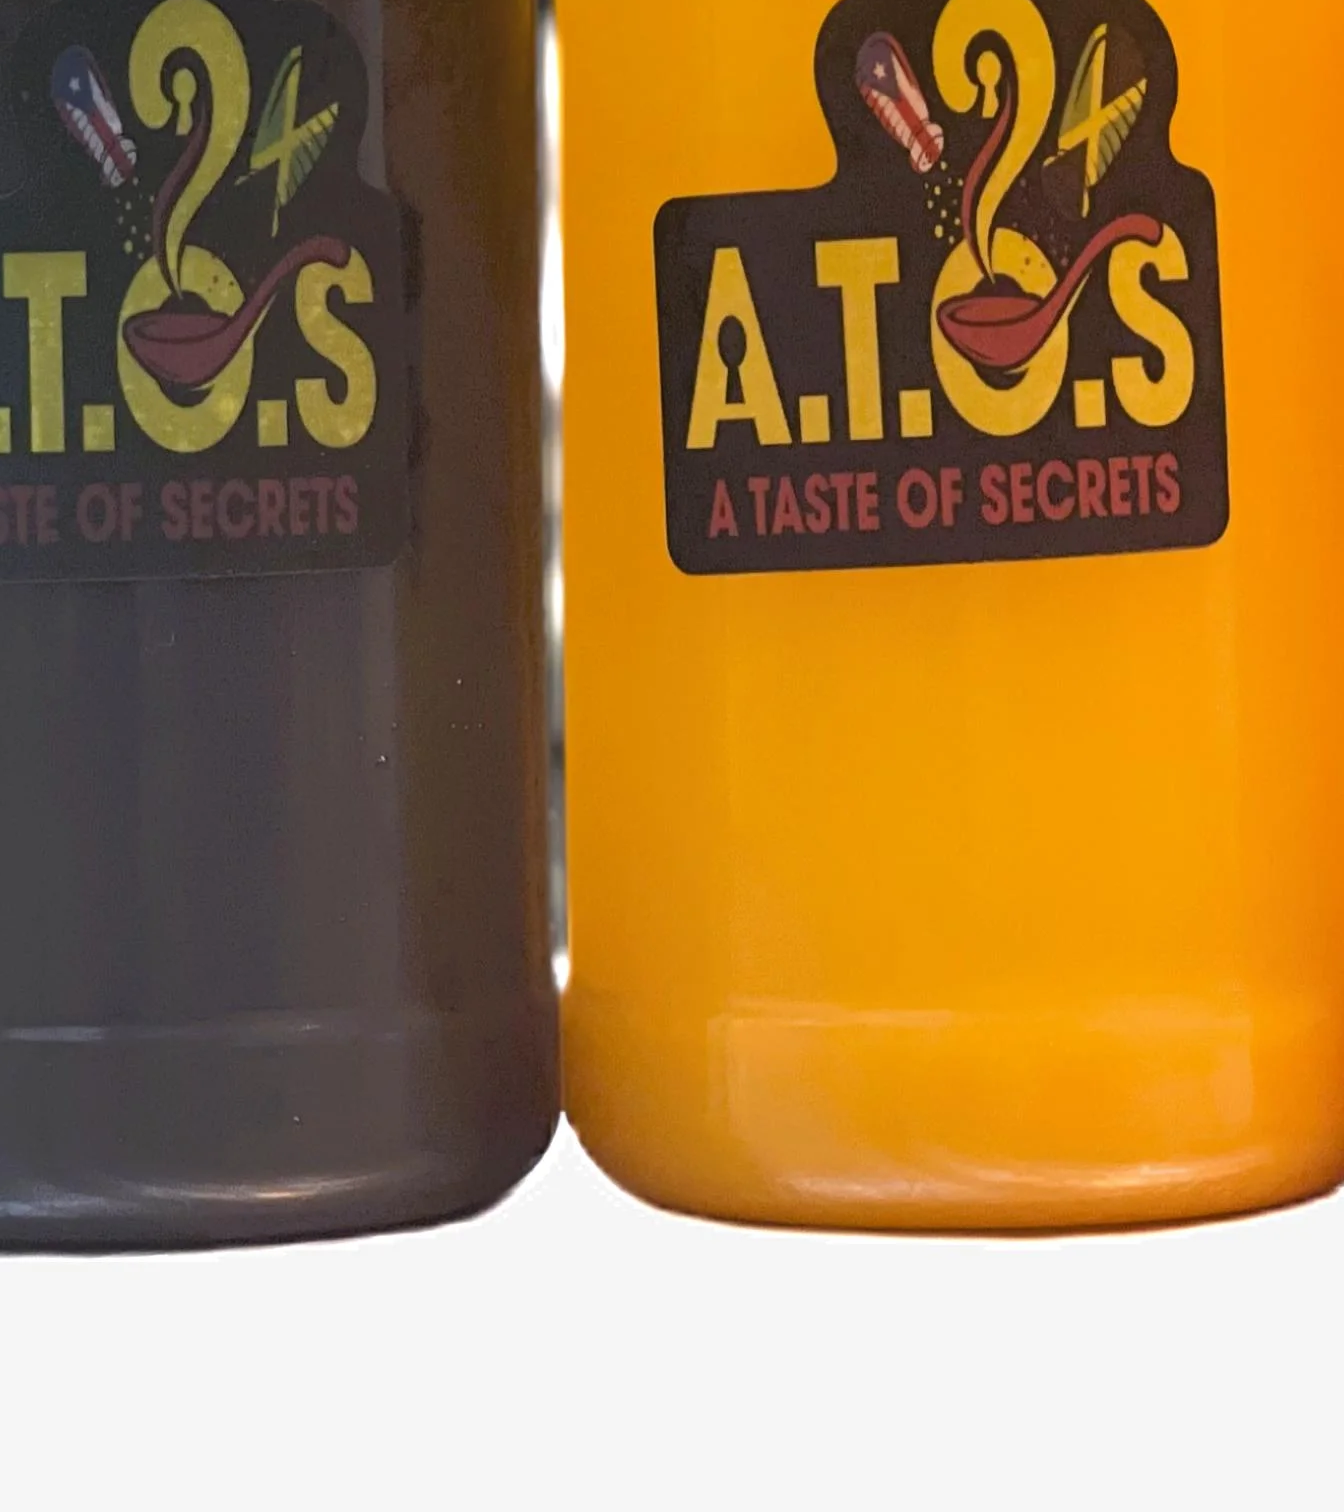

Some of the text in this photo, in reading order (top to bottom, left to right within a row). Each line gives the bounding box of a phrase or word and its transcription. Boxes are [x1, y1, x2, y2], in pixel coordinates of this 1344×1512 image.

[685, 222, 1194, 449] A.T.O.S
[77, 482, 142, 542] OF
[162, 477, 359, 540] SECRETS
[707, 454, 1180, 537] A TASTE OF SECRETS
